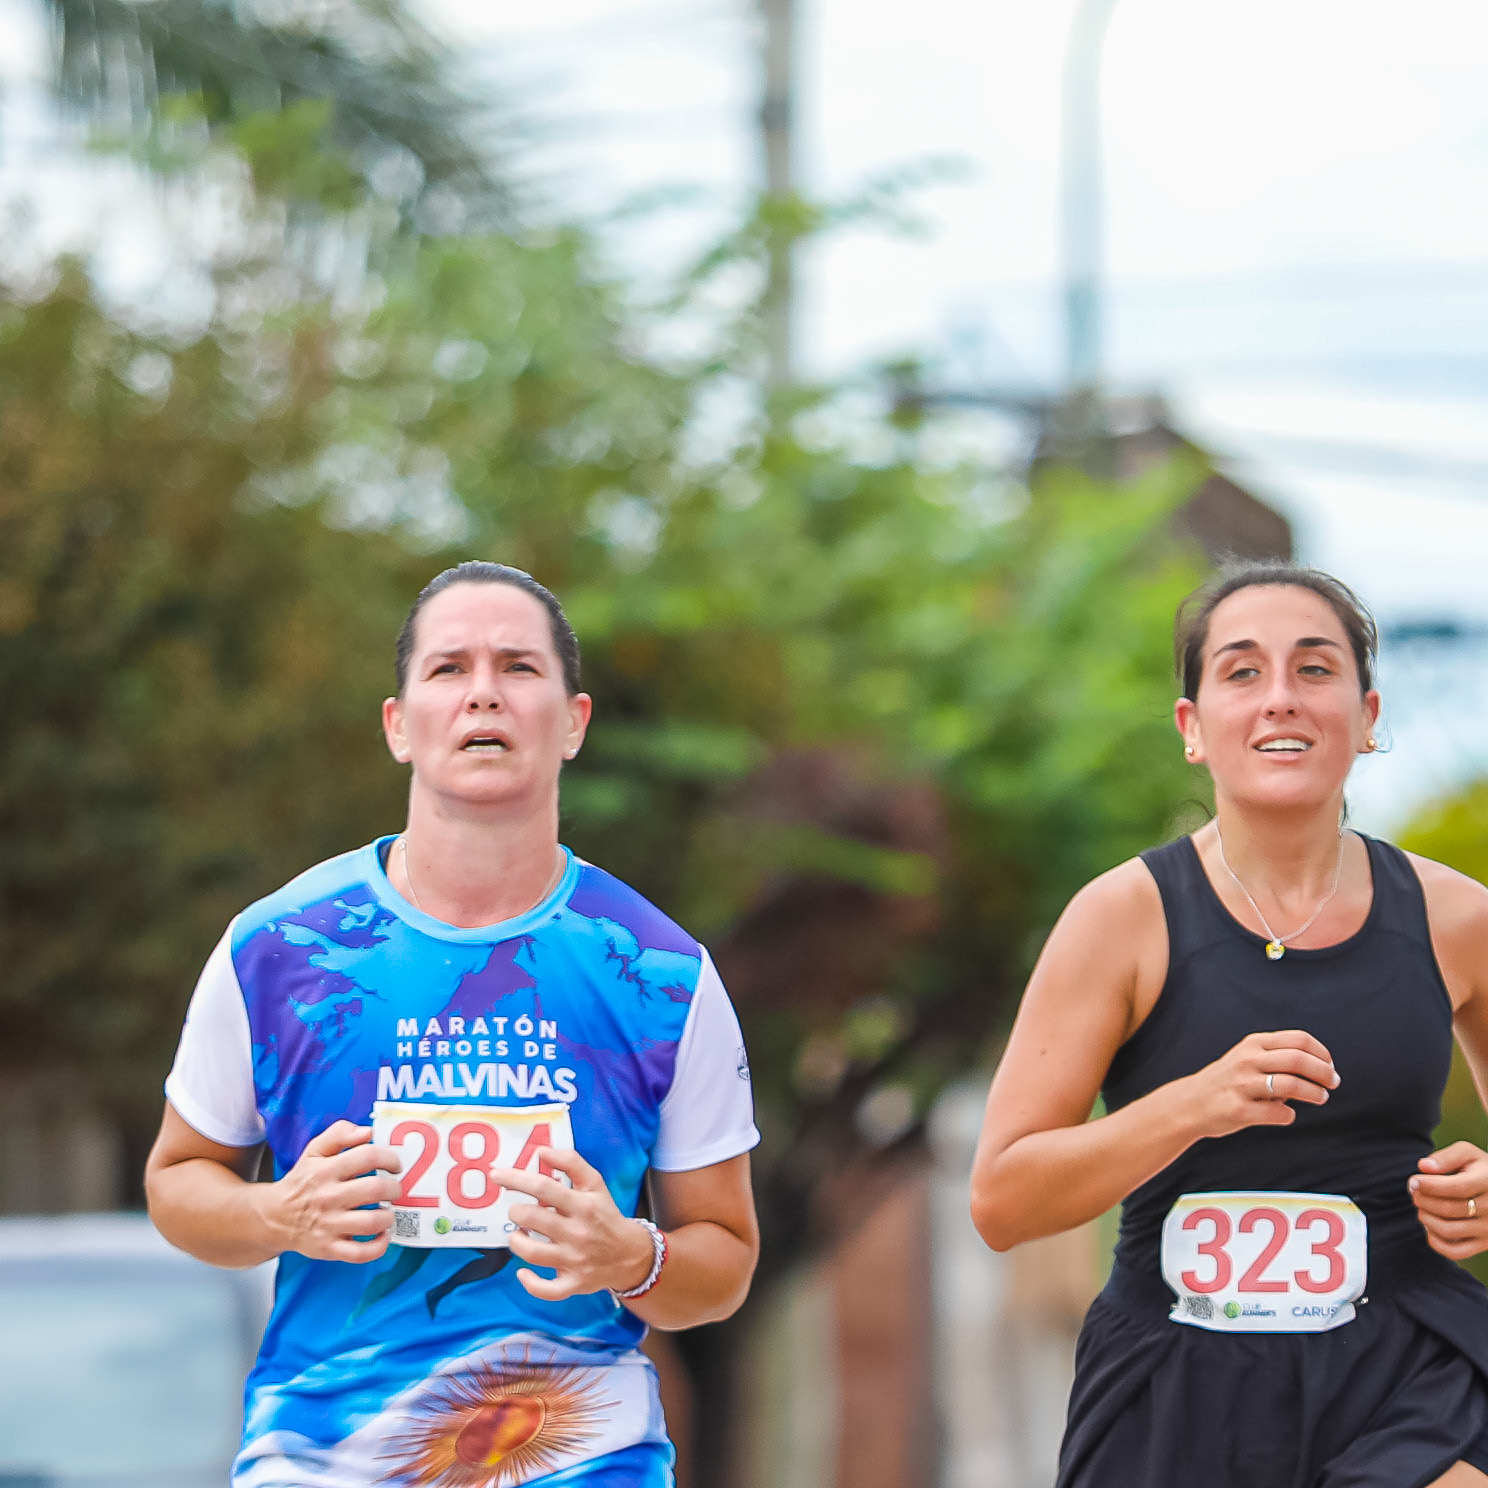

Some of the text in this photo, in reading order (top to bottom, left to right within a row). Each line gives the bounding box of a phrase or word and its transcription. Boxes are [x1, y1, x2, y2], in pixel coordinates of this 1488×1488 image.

[396, 1014, 558, 1039] MARATÓN
[396, 1038, 557, 1061] HÉROES DE
[376, 1062, 578, 1103] MALVINAS
[389, 1120, 562, 1209] 284
[1181, 1207, 1347, 1294] 323
